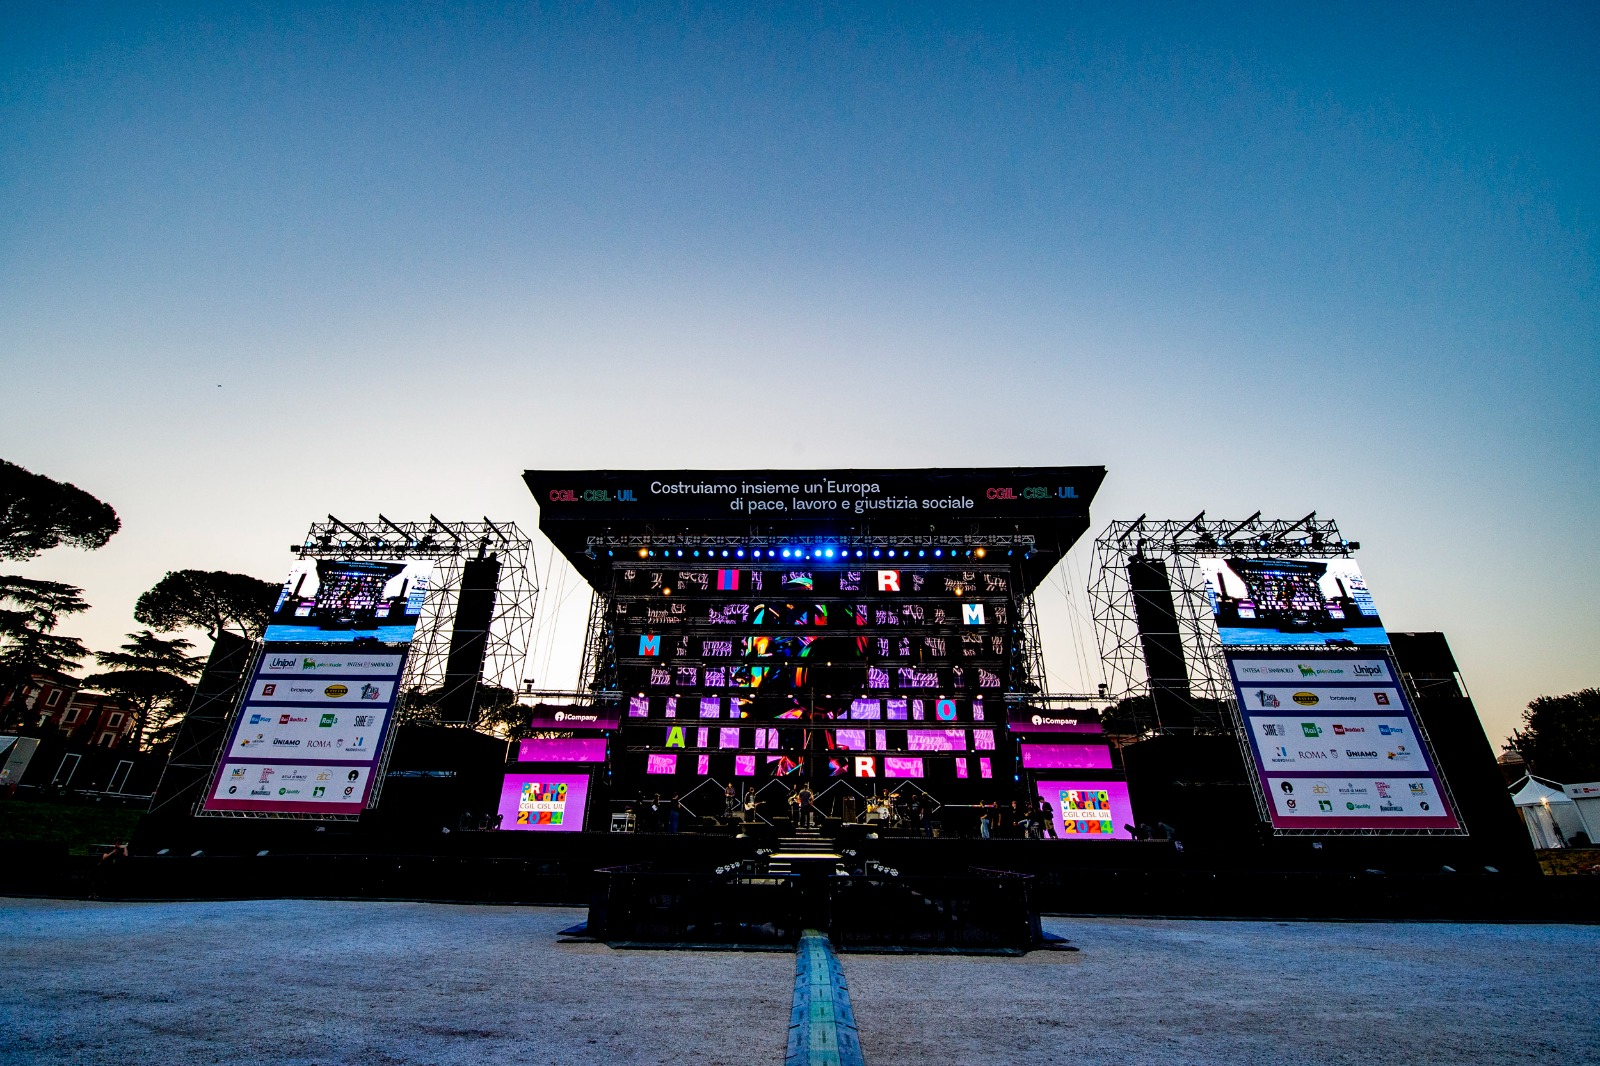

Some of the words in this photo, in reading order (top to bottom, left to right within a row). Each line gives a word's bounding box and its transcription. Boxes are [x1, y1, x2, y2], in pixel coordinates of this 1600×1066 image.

[650, 481, 737, 494] Costruiamo
[742, 480, 800, 494] insieme
[804, 478, 880, 497] un'Europa
[986, 488, 1018, 500] CGIL
[1023, 487, 1052, 499] CISL
[1058, 486, 1078, 498] UIL
[550, 490, 578, 502] CGIL
[584, 490, 612, 502] CISL
[618, 490, 638, 502] UIL
[730, 498, 743, 510] di
[748, 500, 788, 514] pace,
[792, 496, 837, 510] lavoro
[841, 499, 850, 510] e
[854, 496, 918, 514] giustizia
[922, 496, 974, 510] sociale
[878, 570, 900, 591] R
[962, 604, 985, 624] M
[638, 635, 660, 656] M
[270, 658, 296, 669] Unipol
[1353, 664, 1382, 676] Unipol
[564, 714, 597, 722] iCompany
[1042, 717, 1077, 726] iCompany
[666, 726, 686, 747] A
[855, 756, 876, 777] R
[517, 811, 564, 824] 2024
[1064, 820, 1114, 834] 2024
